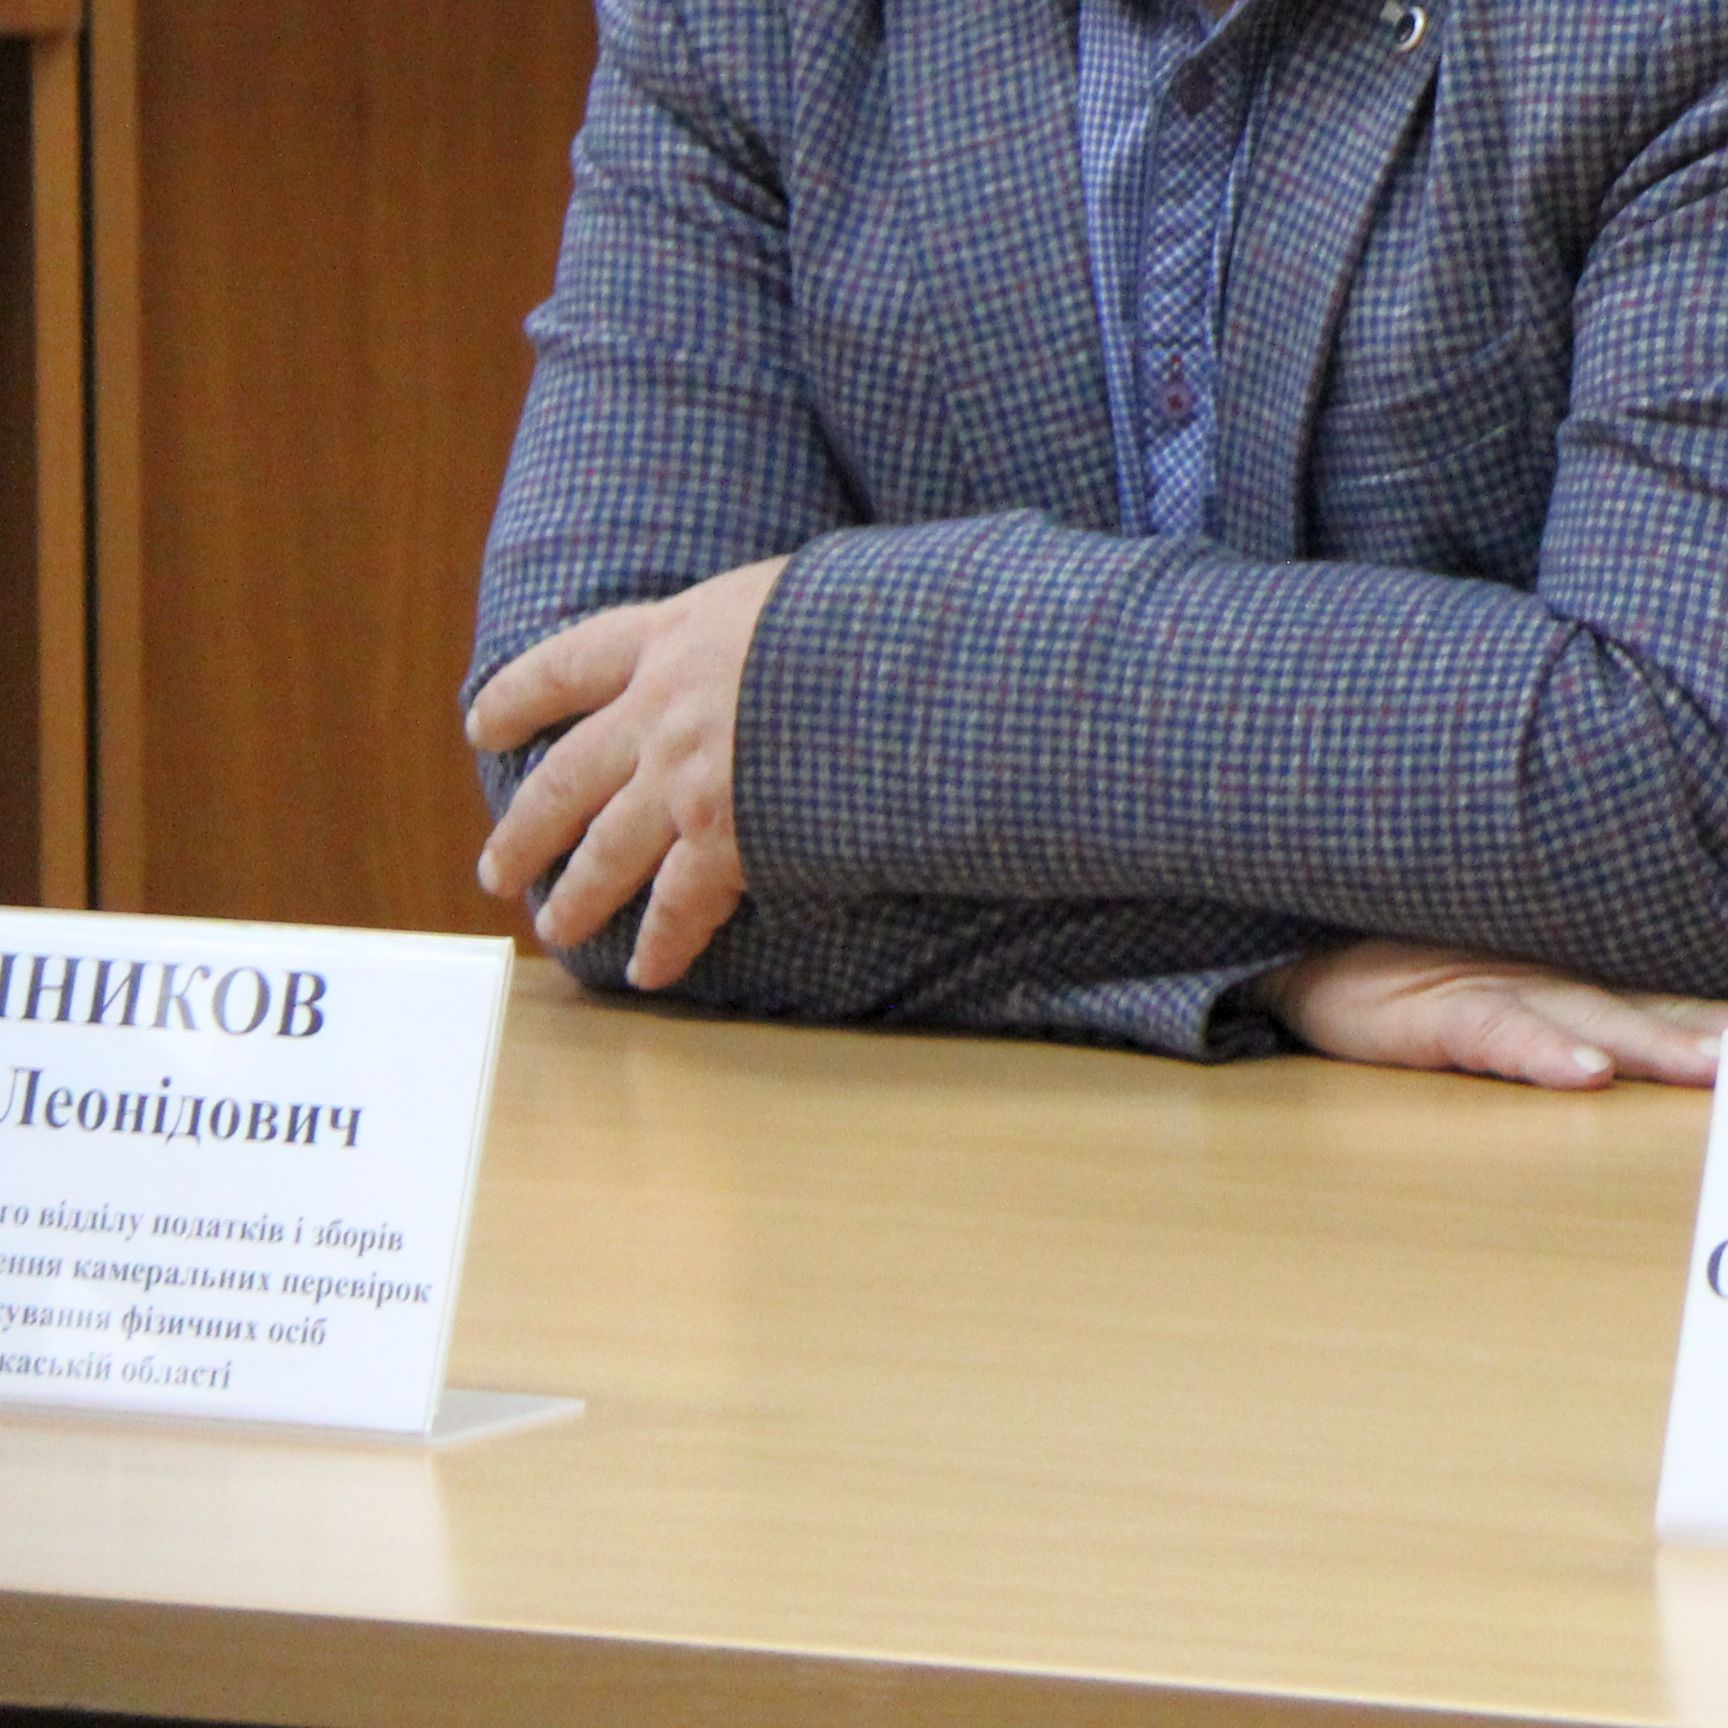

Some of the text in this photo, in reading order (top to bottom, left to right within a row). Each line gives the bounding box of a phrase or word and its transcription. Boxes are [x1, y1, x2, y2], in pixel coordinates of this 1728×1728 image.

[0, 1067, 363, 1148] Леонідович
[37, 1199, 145, 1243] відділу
[151, 1214, 285, 1244] податків
[293, 1215, 305, 1246] і
[314, 1219, 404, 1259] зборів
[72, 1258, 271, 1294] камеральних
[281, 1271, 433, 1310] перевірок
[0, 1302, 328, 1346] ування фізичних осіб
[121, 1355, 233, 1390] області
